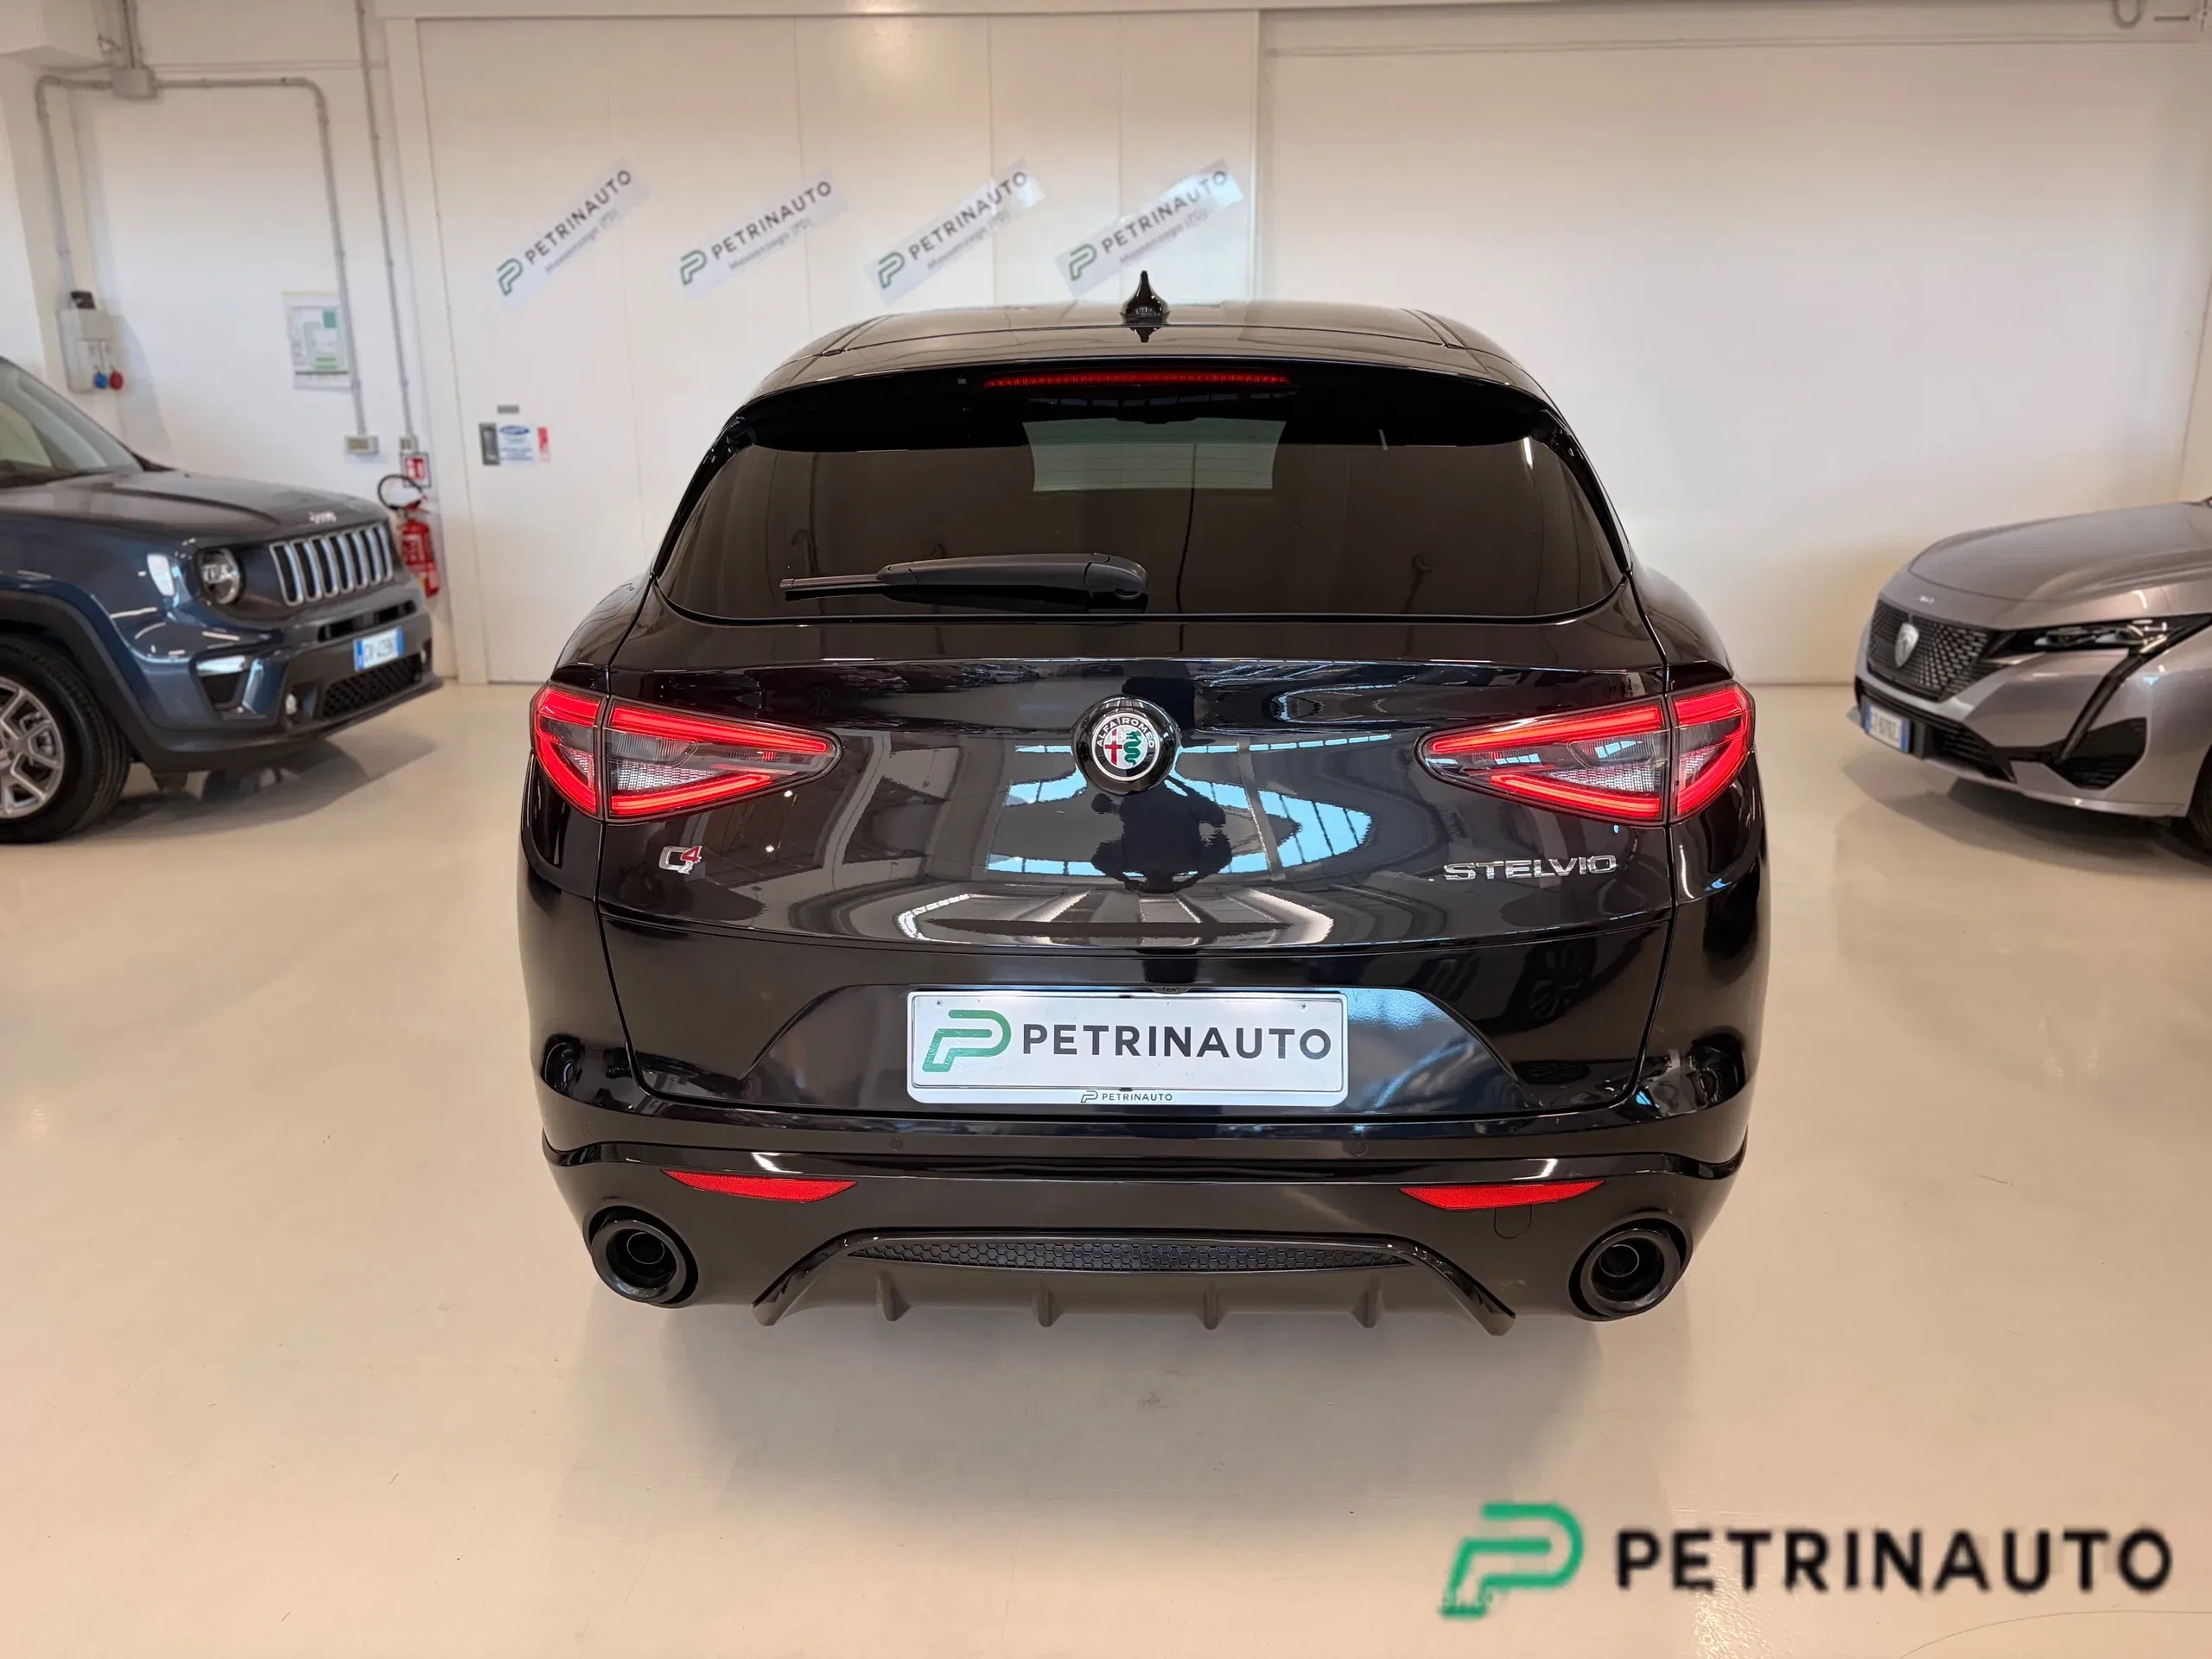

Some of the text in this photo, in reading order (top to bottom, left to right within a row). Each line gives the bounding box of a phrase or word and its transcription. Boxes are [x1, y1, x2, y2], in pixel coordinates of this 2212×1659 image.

[524, 169, 632, 264] PETRINAUTO
[711, 181, 831, 260] PETRINAUTO
[908, 171, 1027, 261] PETRINAUTO
[1101, 170, 1228, 254] PETRINAUTO
[1096, 717, 1155, 748] ALFA ROMEO
[1443, 855, 1617, 880] STELVIO
[1022, 1023, 1332, 1060] PETRINAUTO
[1102, 1092, 1173, 1102] PETRINAUTO
